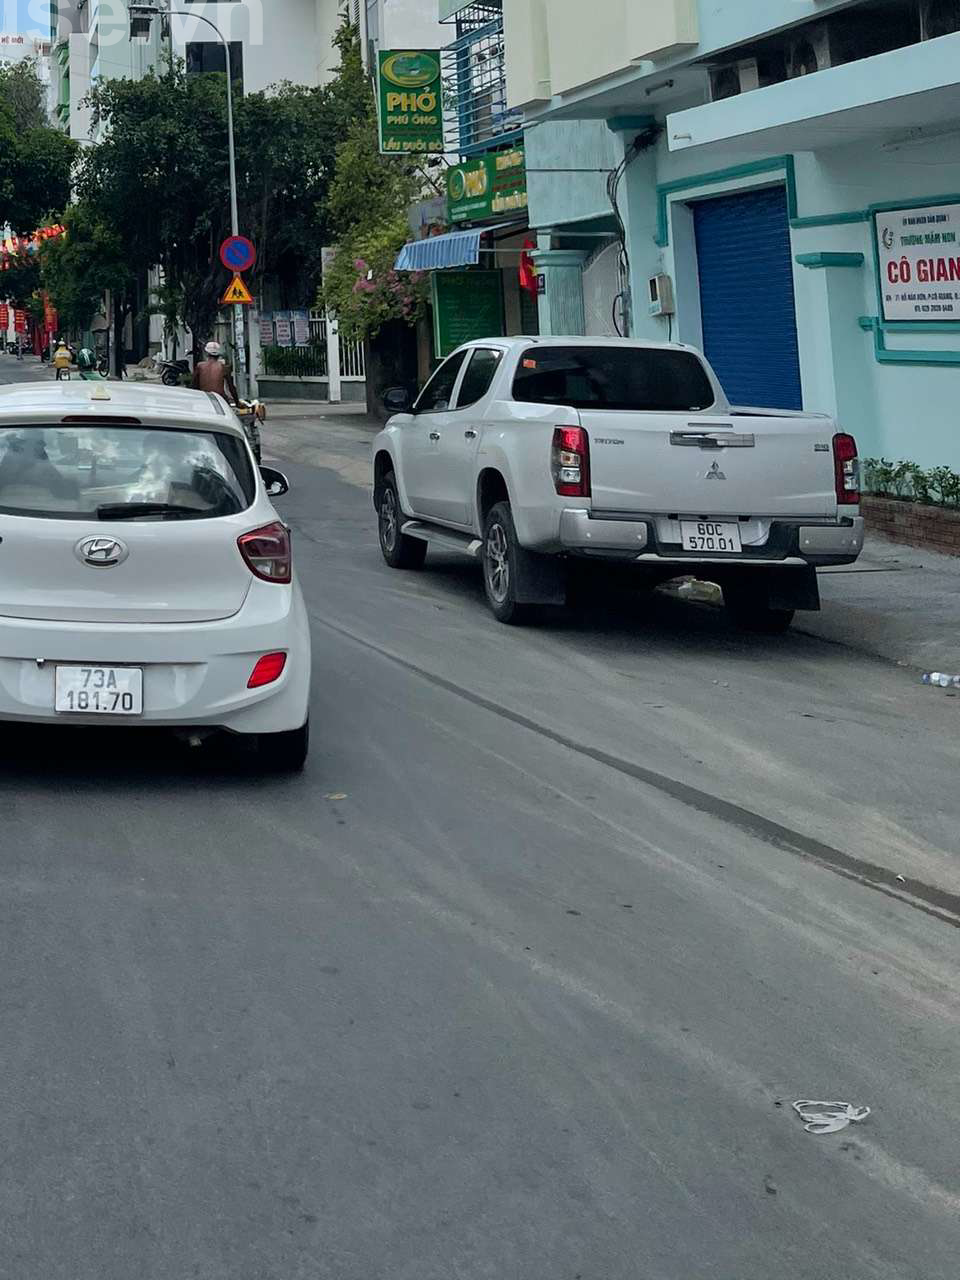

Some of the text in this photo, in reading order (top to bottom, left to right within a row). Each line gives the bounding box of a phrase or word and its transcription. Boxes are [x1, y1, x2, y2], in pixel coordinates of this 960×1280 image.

[386, 86, 437, 113] PHỞ
[887, 255, 911, 284] CÔ
[697, 523, 723, 536] 60C
[689, 537, 735, 551] 570.01
[80, 669, 117, 689] 73A
[66, 690, 134, 711] 181.70
